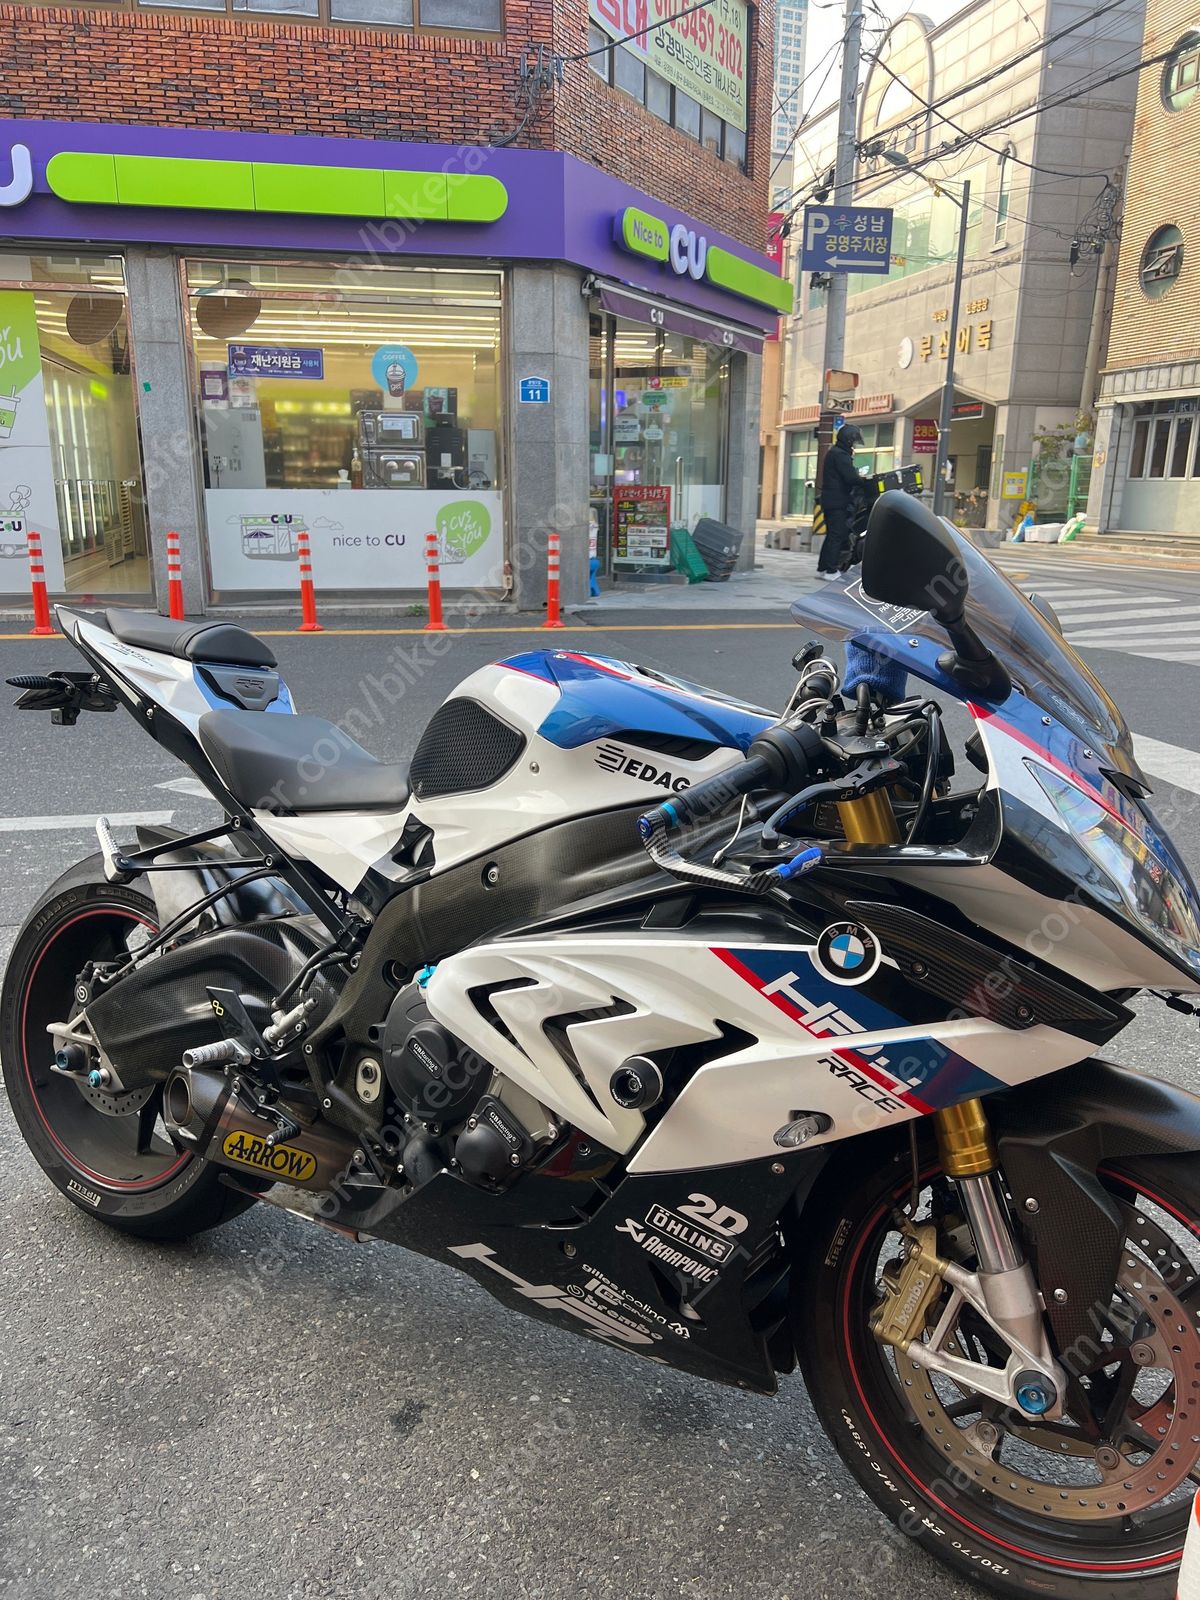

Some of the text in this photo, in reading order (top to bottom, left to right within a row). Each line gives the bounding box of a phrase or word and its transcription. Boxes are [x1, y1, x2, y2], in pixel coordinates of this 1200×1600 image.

[806, 213, 830, 251] P
[854, 215, 885, 233] 성남
[632, 218, 707, 281] Nice to CU
[825, 235, 888, 254] 공영주차장
[650, 308, 665, 325] CU
[251, 354, 302, 369] 재난지원금
[528, 389, 541, 401] 11
[271, 514, 292, 524] CU
[333, 534, 406, 546] nice to CU
[827, 924, 875, 949] BMW
[817, 1056, 907, 1114] RACE
[229, 1134, 313, 1175] ARROW
[66, 1179, 101, 1208] PIRELLI
[677, 1193, 749, 1237] 2D
[651, 1211, 725, 1260] ÖHLINS
[581, 1263, 667, 1325] gilles.tooling
[896, 1278, 926, 1327] brembo
[584, 1295, 664, 1340] brembo
[920, 1517, 946, 1537] ZR
